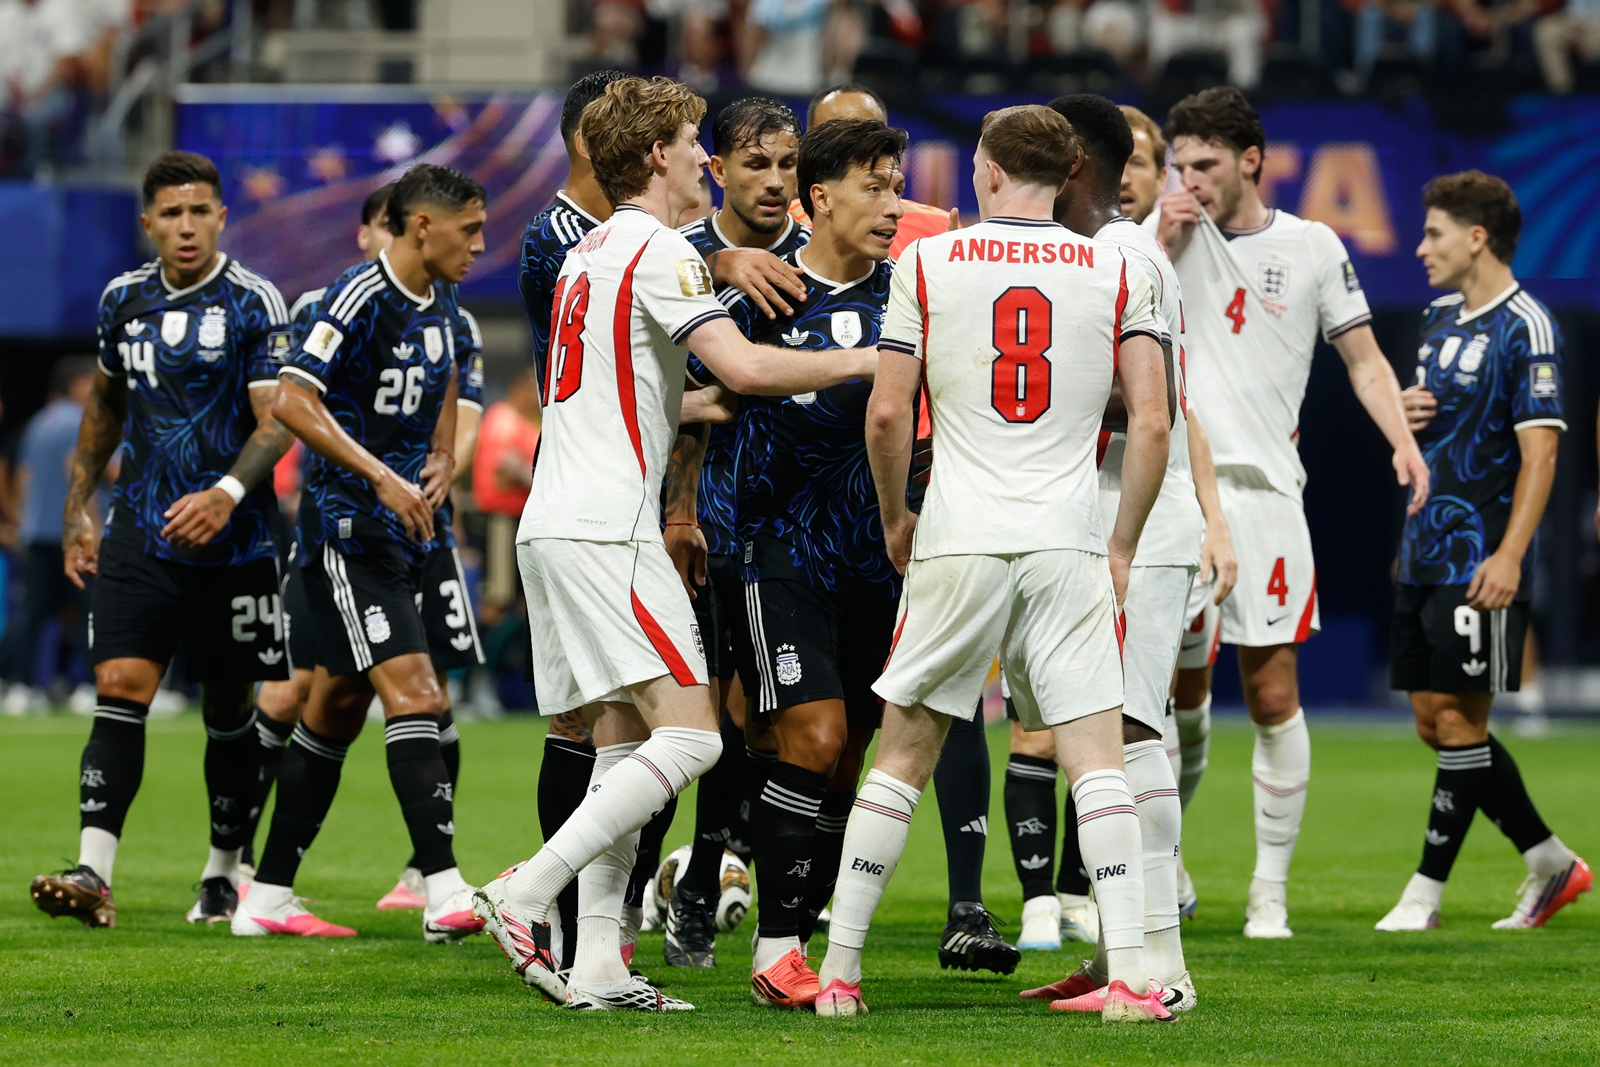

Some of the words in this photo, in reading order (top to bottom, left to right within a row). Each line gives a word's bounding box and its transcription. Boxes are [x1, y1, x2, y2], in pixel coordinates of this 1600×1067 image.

[948, 238, 1094, 269] ANDERSON
[1225, 287, 1246, 334] 4
[991, 286, 1052, 424] 8
[373, 366, 425, 416] 26
[439, 579, 467, 629] 3
[1267, 557, 1289, 606] 4
[231, 593, 284, 642] 24
[1453, 604, 1481, 654] 9
[851, 857, 885, 876] ENG
[1096, 863, 1127, 881] ENG
